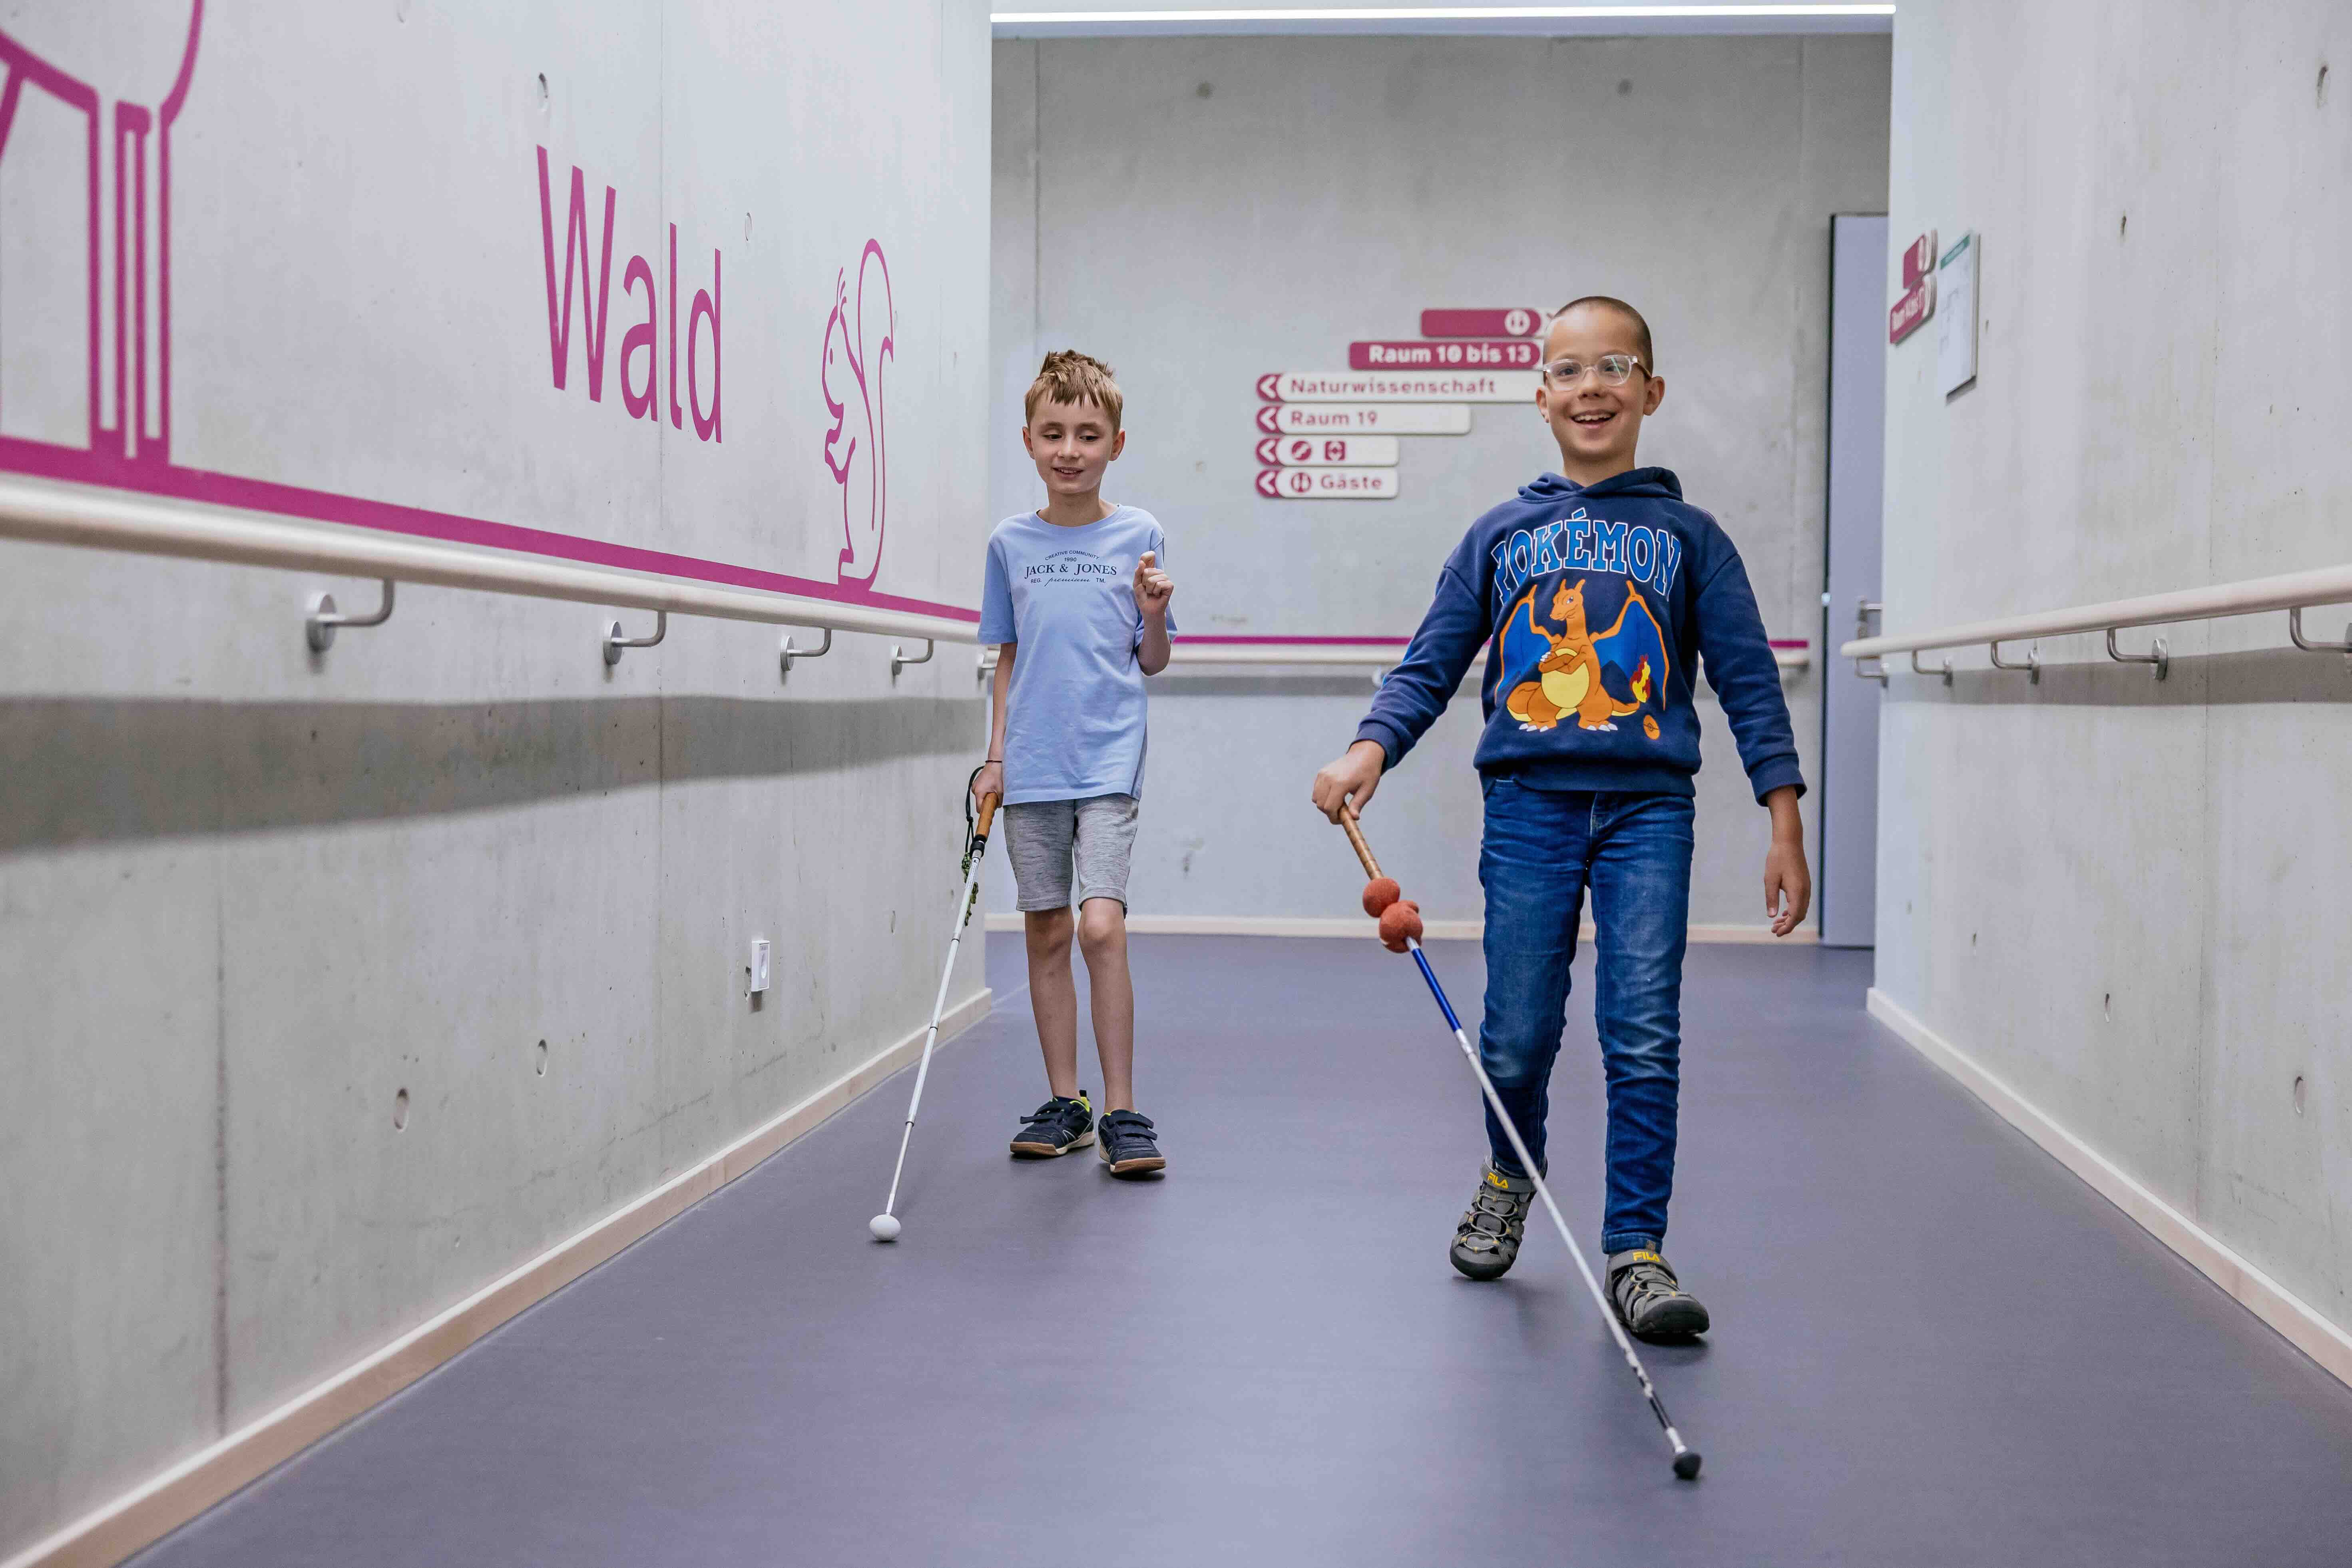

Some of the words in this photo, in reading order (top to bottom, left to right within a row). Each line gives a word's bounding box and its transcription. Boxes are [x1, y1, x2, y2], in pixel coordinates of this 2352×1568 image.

[537, 144, 722, 444] Wald
[1369, 345, 1431, 363] Raum
[1437, 345, 1462, 363] 10
[1466, 344, 1502, 363] bis
[1507, 345, 1531, 363] 13
[1291, 377, 1496, 394] Naturwissenschaft
[1291, 411, 1349, 426] Raum
[1358, 411, 1377, 425] 19
[1320, 473, 1382, 490] Gäste
[1045, 550, 1068, 560] CREATIVE
[1069, 550, 1100, 560] COMMUNITY
[1491, 507, 1682, 607] POKÉMON
[1024, 564, 1055, 579] JACK
[1059, 564, 1068, 572] &
[1074, 564, 1117, 576] JONES
[1044, 577, 1091, 587] premium
[1488, 1172, 1508, 1189] FILA
[1633, 1251, 1660, 1262] FILA
